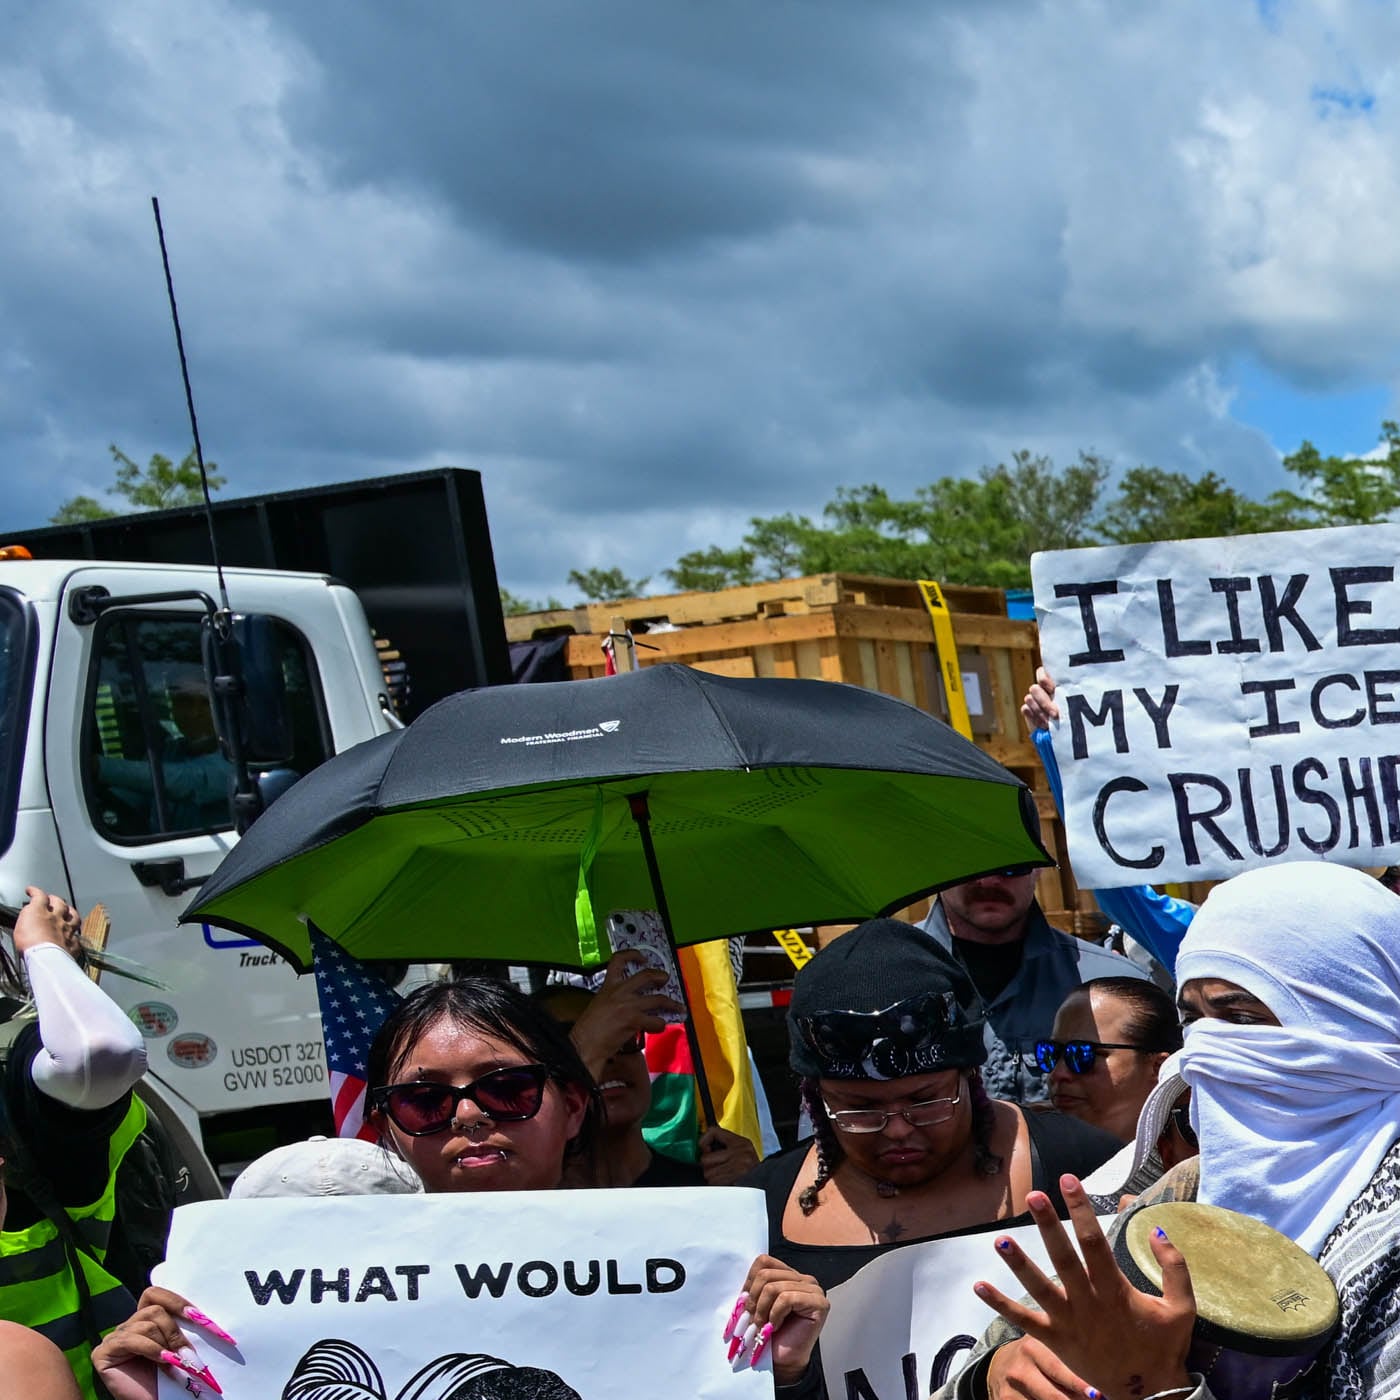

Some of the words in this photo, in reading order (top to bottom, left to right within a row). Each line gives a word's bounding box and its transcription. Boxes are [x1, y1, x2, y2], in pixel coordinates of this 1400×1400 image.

[1054, 580, 1124, 667] I
[1156, 566, 1400, 658] LIKE
[501, 735, 543, 744] Modern
[544, 728, 599, 739] Woodmen
[1066, 684, 1180, 760] MY
[239, 952, 277, 967] Truck
[232, 1046, 292, 1068] USDOT
[296, 1042, 322, 1061] 327
[224, 1071, 267, 1092] GVW
[273, 1064, 324, 1086] 52000
[244, 1264, 430, 1307] WHAT
[454, 1258, 687, 1300] WOULD
